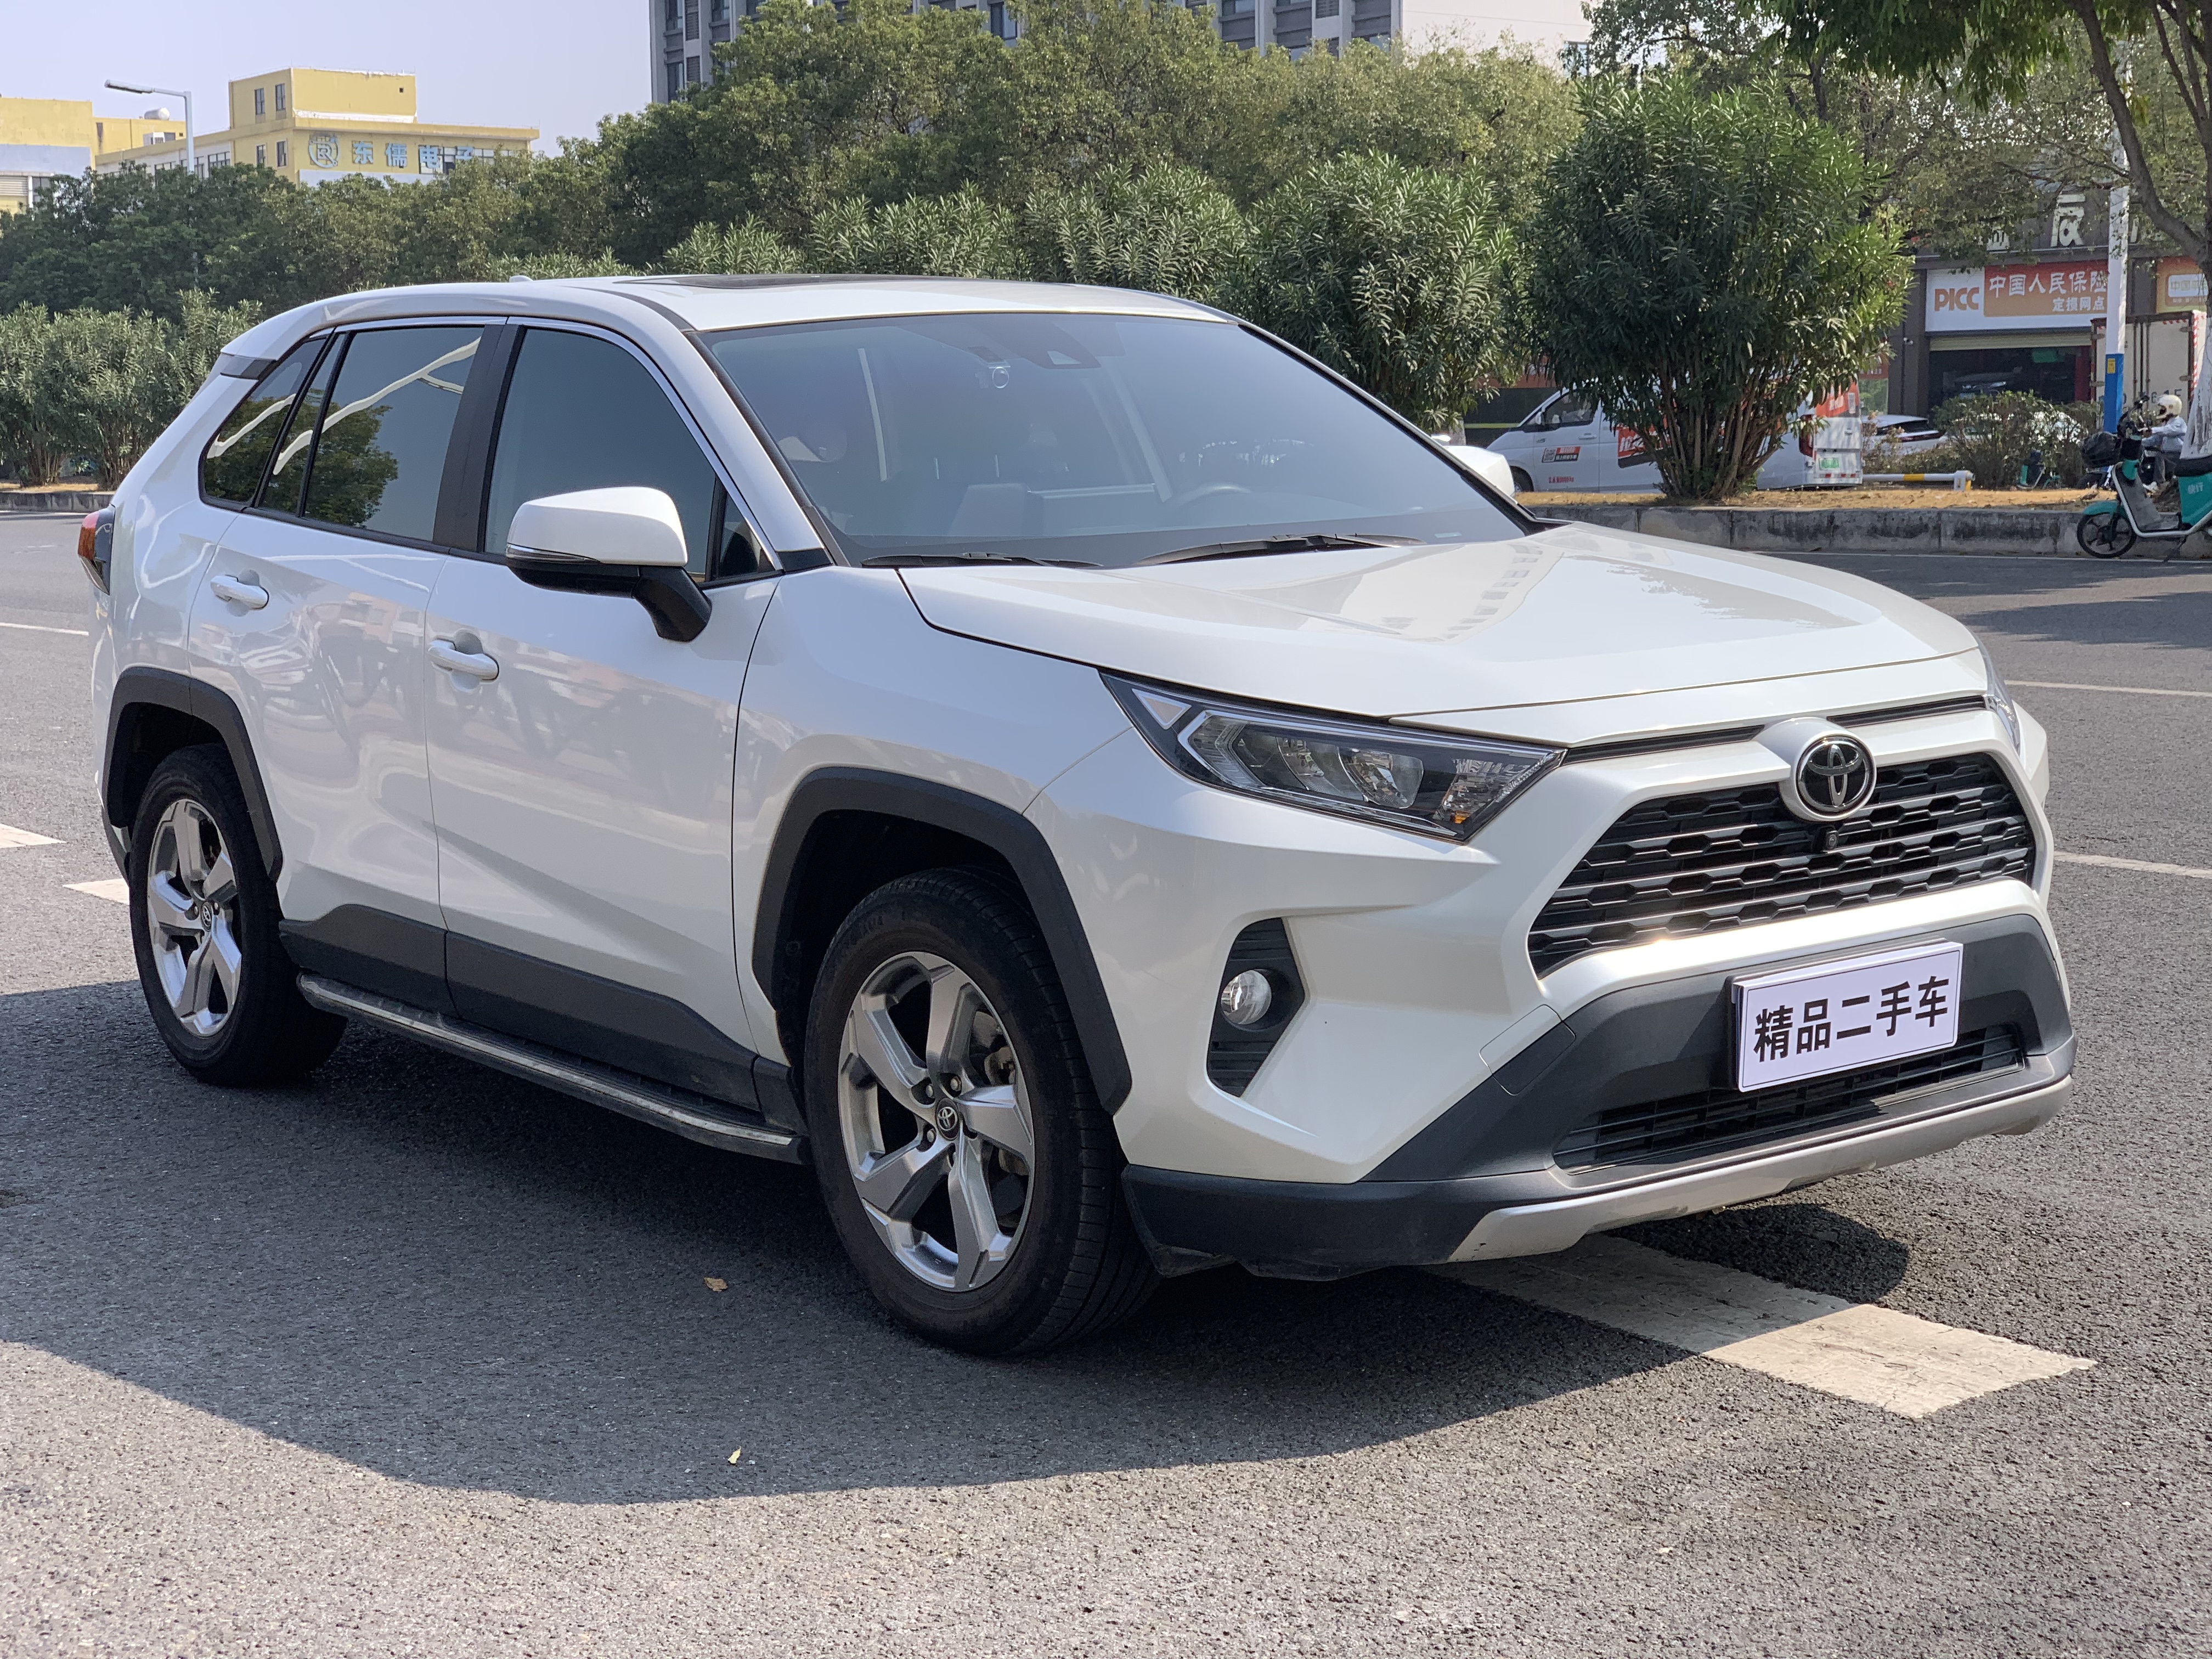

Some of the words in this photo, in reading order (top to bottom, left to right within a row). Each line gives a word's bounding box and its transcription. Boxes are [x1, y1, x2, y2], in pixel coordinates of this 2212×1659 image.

[1989, 270, 2107, 298] 中国人民保险
[1934, 287, 1979, 312] PICC
[2052, 296, 2105, 312] 定损网点
[1753, 975, 1950, 1063] 精品二手车
